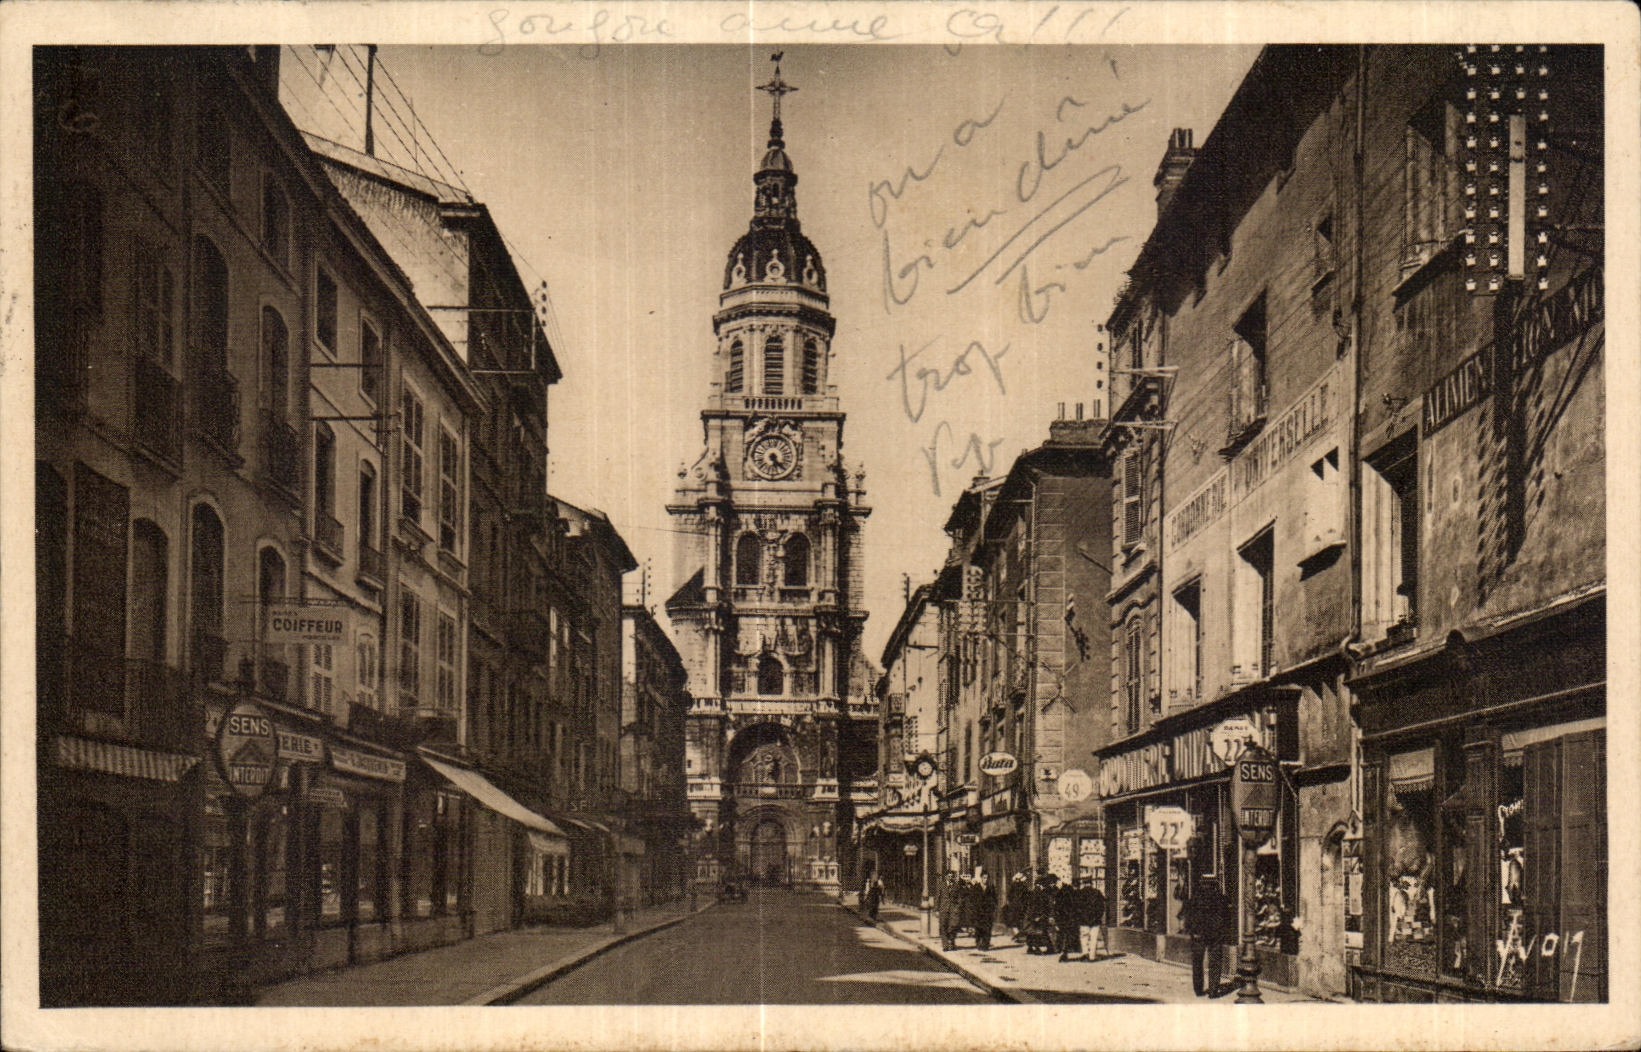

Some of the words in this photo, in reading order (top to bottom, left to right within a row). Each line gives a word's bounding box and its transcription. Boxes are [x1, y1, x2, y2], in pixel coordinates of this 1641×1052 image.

[952, 94, 1006, 147] a
[882, 208, 1008, 316] bien
[885, 333, 1011, 424] trop
[272, 618, 343, 634] COIFFEUR
[230, 716, 270, 736] SENS
[982, 755, 1015, 770] Bata
[1240, 762, 1274, 782] SENS
